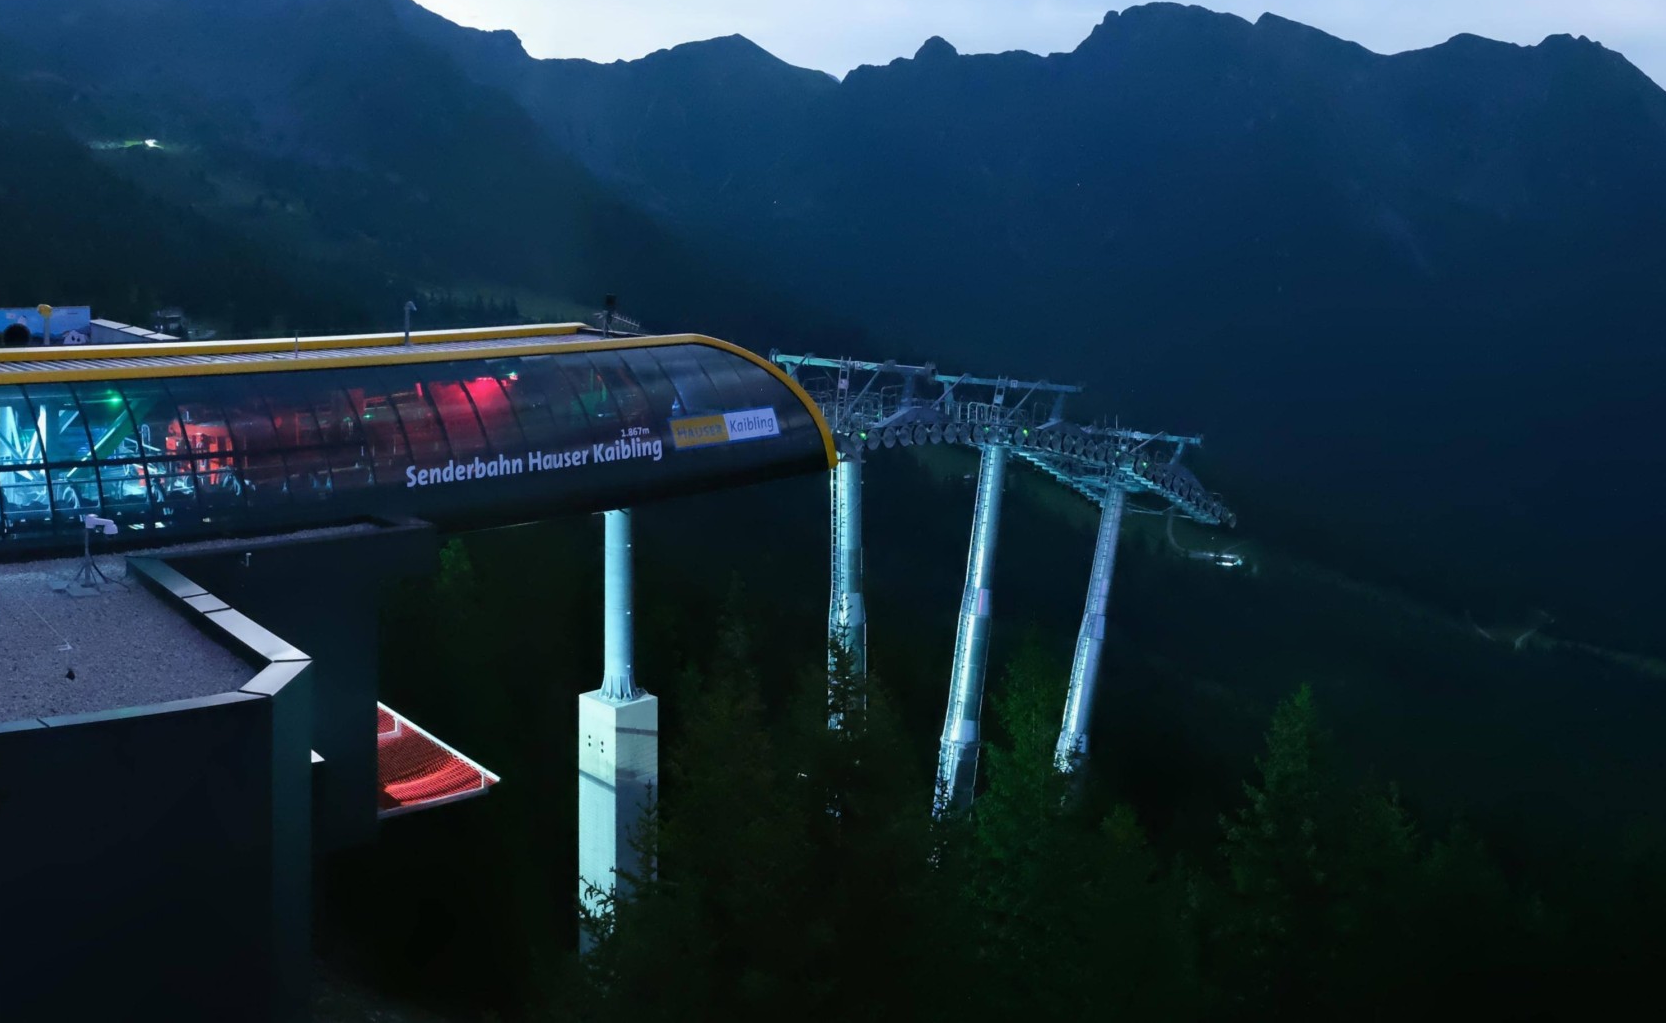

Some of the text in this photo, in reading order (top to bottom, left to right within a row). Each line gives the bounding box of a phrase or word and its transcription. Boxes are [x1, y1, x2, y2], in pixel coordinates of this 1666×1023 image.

[620, 426, 650, 437] 1.867m
[677, 416, 774, 439] HAUSER Kaibling
[406, 437, 663, 488] Senderbahn Hauser Kaibling
